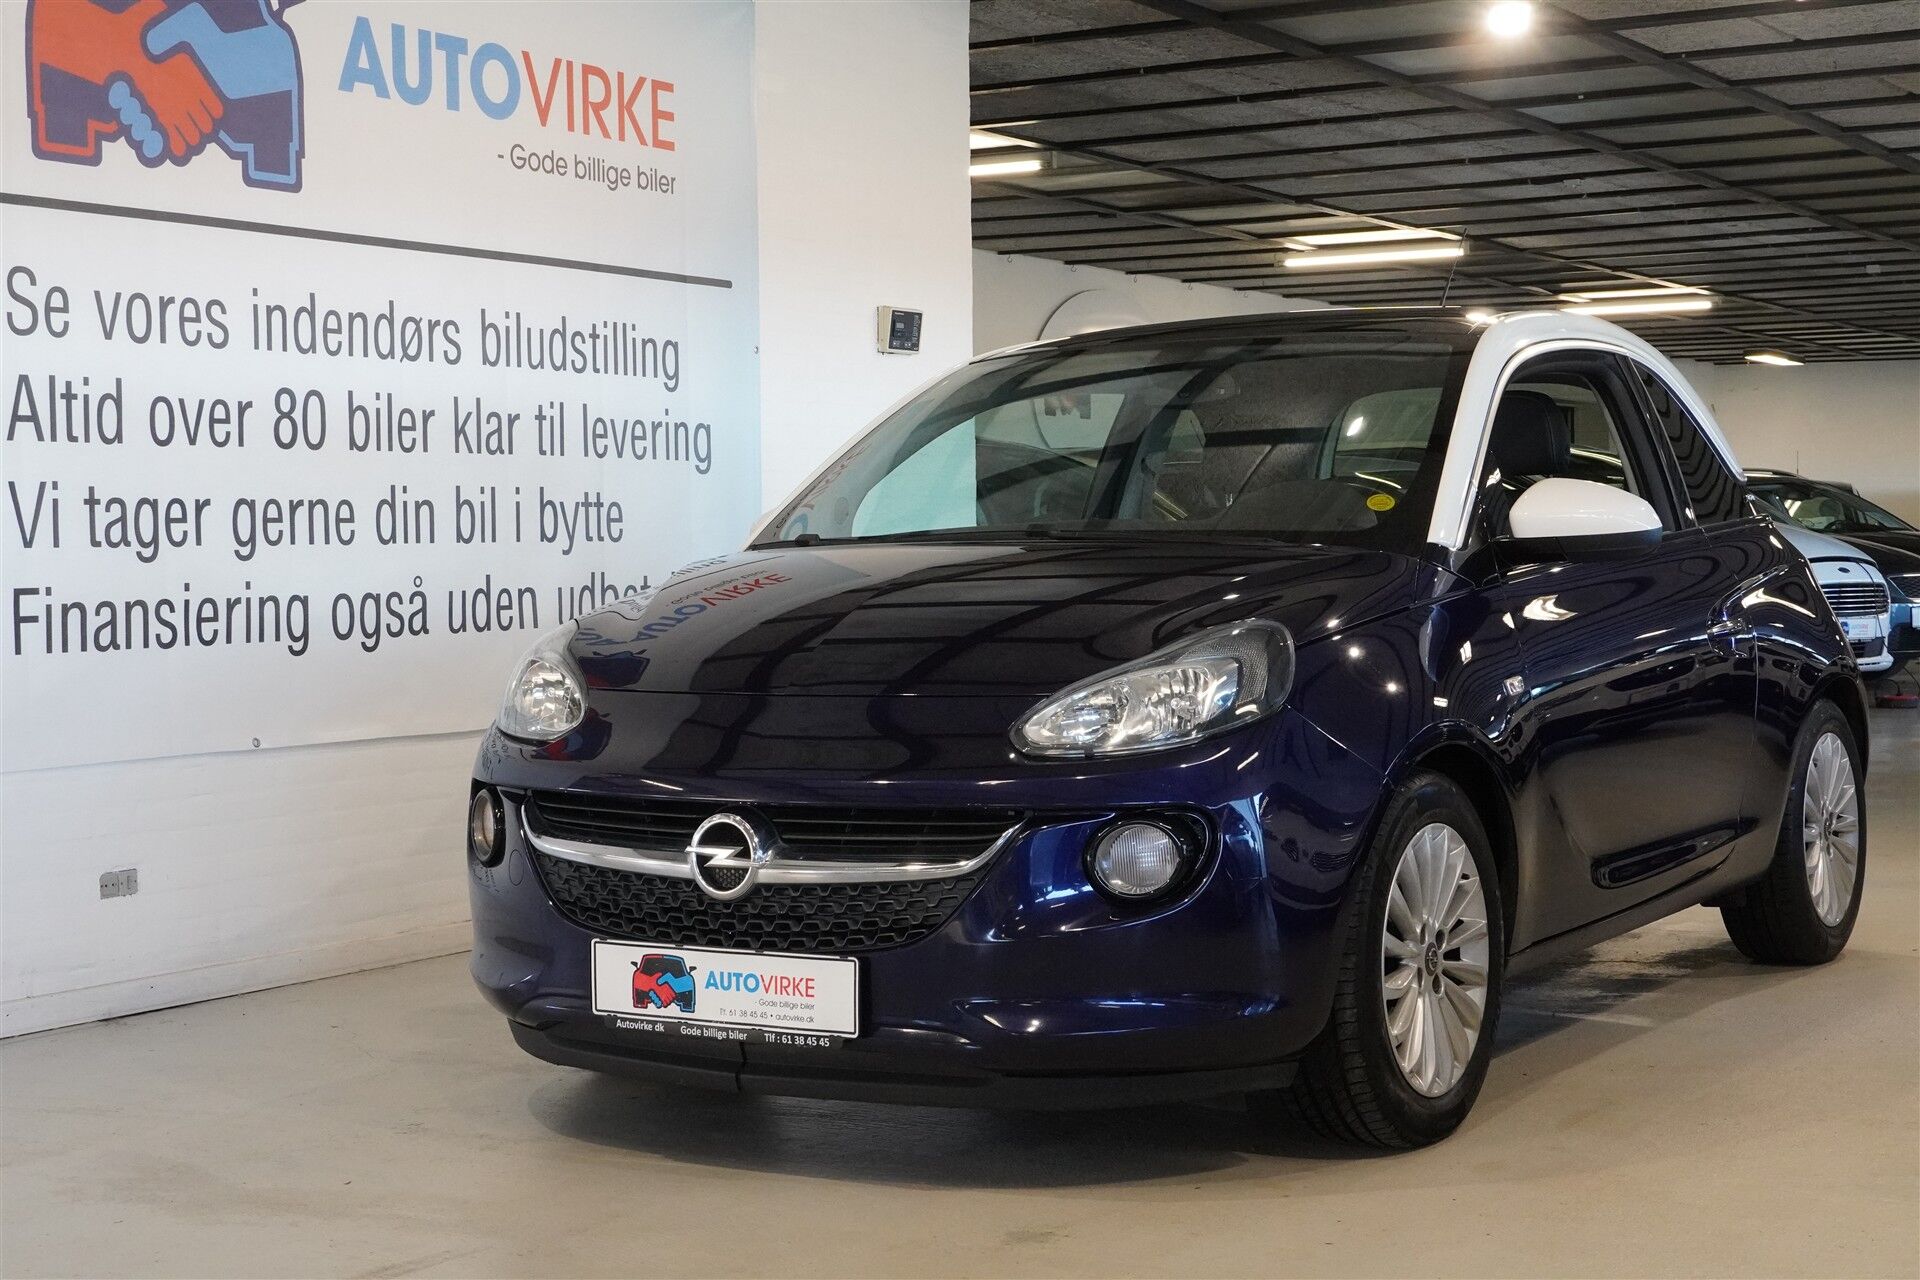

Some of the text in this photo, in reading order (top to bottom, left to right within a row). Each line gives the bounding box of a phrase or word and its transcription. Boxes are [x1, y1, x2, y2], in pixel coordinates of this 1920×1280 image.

[338, 16, 677, 152] AUTOVIRKE
[510, 143, 568, 177] Gode
[574, 154, 632, 192] billige
[637, 165, 676, 195] biler
[6, 265, 680, 393] Se vores indendørs biludstilling
[6, 373, 714, 475] Altid over 80 biler klar til levering
[8, 480, 625, 563] Vi tager gerne din bil i bytte
[12, 582, 312, 657] Finansiering
[331, 575, 430, 654] også
[448, 573, 540, 638] uden
[704, 970, 815, 998] AUTOVIRKE
[729, 1009, 737, 1017] 61
[739, 1009, 748, 1018] 38
[749, 1010, 758, 1018] 45
[759, 1011, 768, 1019] 45
[758, 998, 778, 1008] Gode
[779, 1000, 799, 1010] billige
[800, 1002, 815, 1011] biler
[616, 1019, 653, 1031] Autovirke
[680, 1026, 748, 1041] Gode billige biler
[764, 1033, 776, 1043] Tlf
[781, 1034, 792, 1044] 61
[794, 1035, 805, 1045] 38
[806, 1036, 817, 1046] 45
[818, 1037, 830, 1047] 45
